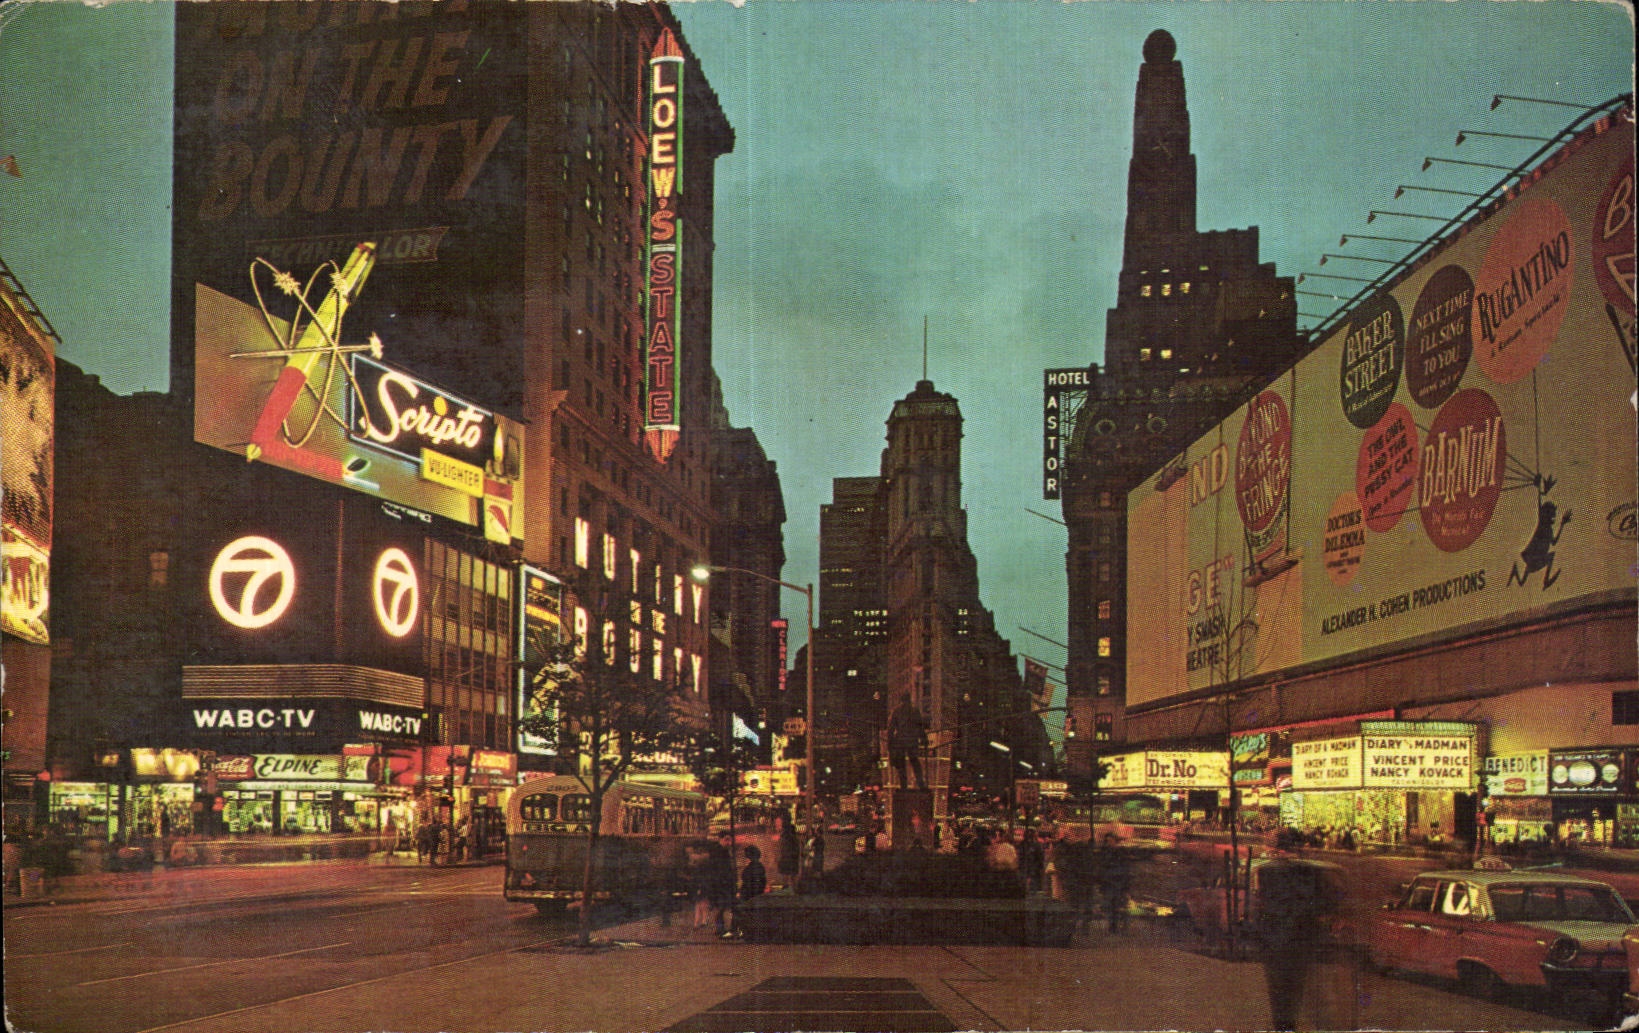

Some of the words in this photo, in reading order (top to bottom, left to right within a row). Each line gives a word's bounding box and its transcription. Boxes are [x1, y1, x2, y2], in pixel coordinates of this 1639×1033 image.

[336, 30, 471, 114] THE
[198, 115, 515, 221] BOUNTY
[651, 64, 676, 240] LOEW'S
[1416, 305, 1442, 329] NEXT
[1446, 289, 1470, 316] TIME
[1441, 317, 1464, 341] SING
[649, 253, 675, 423] STATE
[1346, 311, 1394, 366] BAKER
[1424, 357, 1437, 375] TO
[1439, 344, 1460, 369] YOU
[1048, 372, 1090, 385] HOTEL
[1345, 340, 1396, 399] STREET
[359, 371, 484, 448] Scripto
[1047, 396, 1058, 491] ASTOR
[1395, 446, 1414, 473] CAT
[1421, 416, 1502, 507] BARNUM
[1191, 444, 1229, 507] ND
[1321, 607, 1367, 636] ALEXANDER
[1380, 593, 1410, 620] COHEN
[1412, 569, 1486, 610] PRODUCTIONS
[1367, 739, 1402, 749] DIARY
[1415, 739, 1467, 750] MADMAN
[1371, 767, 1410, 777] NANCY
[1418, 767, 1463, 777] KOVACK
[1372, 755, 1425, 766] VINCENT
[1434, 755, 1469, 766] PRICE
[1487, 755, 1546, 773] BENEDICT
